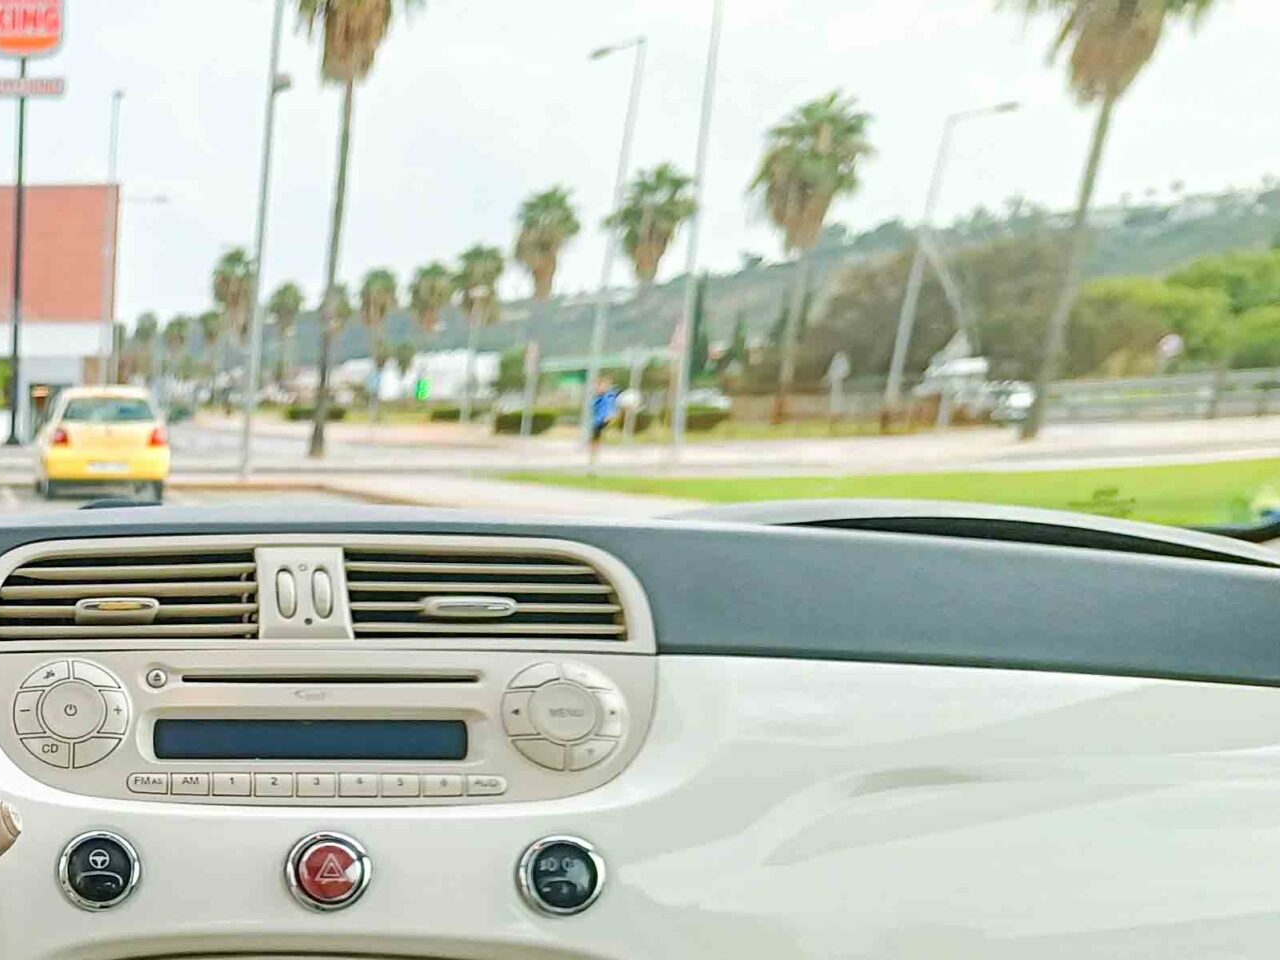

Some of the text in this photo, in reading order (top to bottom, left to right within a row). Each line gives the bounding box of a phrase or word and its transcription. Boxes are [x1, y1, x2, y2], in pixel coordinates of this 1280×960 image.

[42, 744, 59, 754] CD
[181, 776, 200, 785] AM
[270, 777, 278, 786] 2
[313, 777, 320, 786] 3
